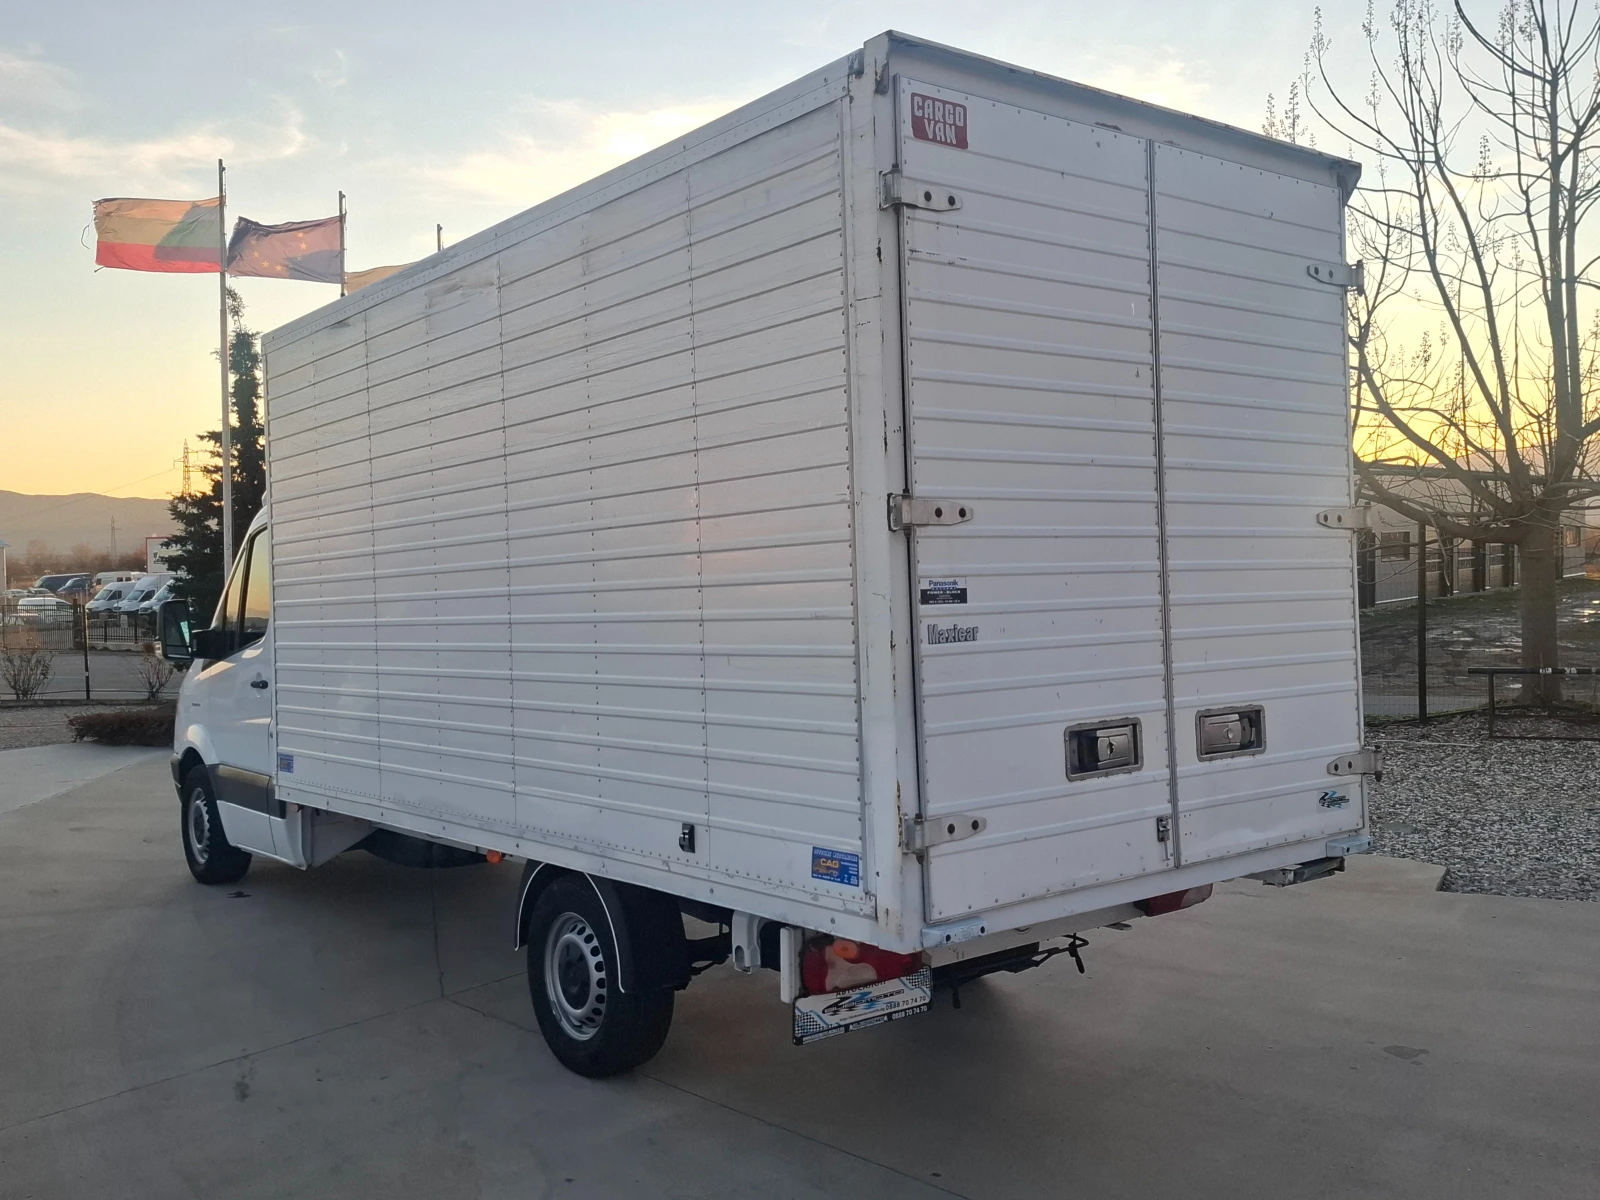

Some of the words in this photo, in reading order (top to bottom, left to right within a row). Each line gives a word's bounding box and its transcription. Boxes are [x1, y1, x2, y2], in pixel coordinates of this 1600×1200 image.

[914, 96, 963, 126] CARGO
[924, 119, 956, 144] VAN
[929, 579, 958, 587] Panasonic
[927, 624, 978, 645] Maxicar
[820, 858, 839, 868] CAG
[885, 1001, 900, 1010] 0888
[910, 997, 918, 1005] 74
